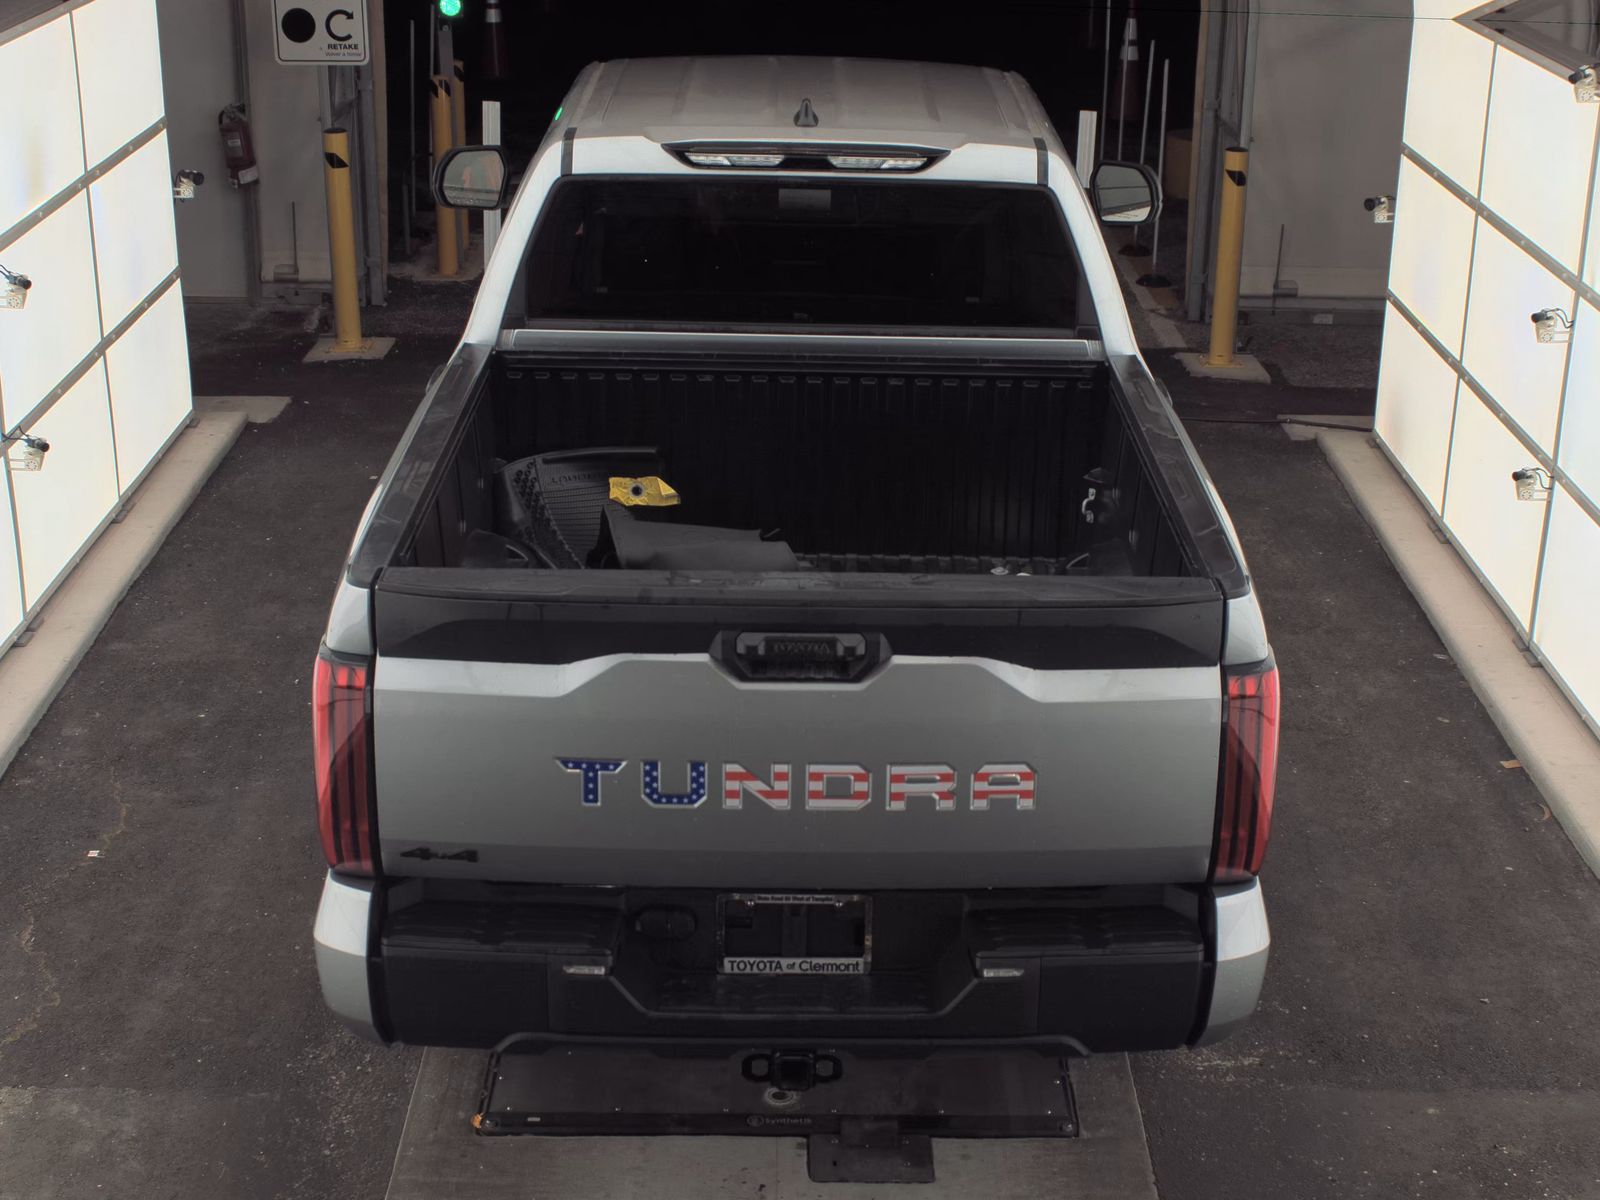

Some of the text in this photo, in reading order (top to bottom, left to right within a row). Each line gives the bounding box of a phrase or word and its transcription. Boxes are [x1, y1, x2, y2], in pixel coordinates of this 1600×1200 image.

[555, 757, 1038, 811] TUNDRA
[727, 959, 860, 972] TOYOTA of Clermont
